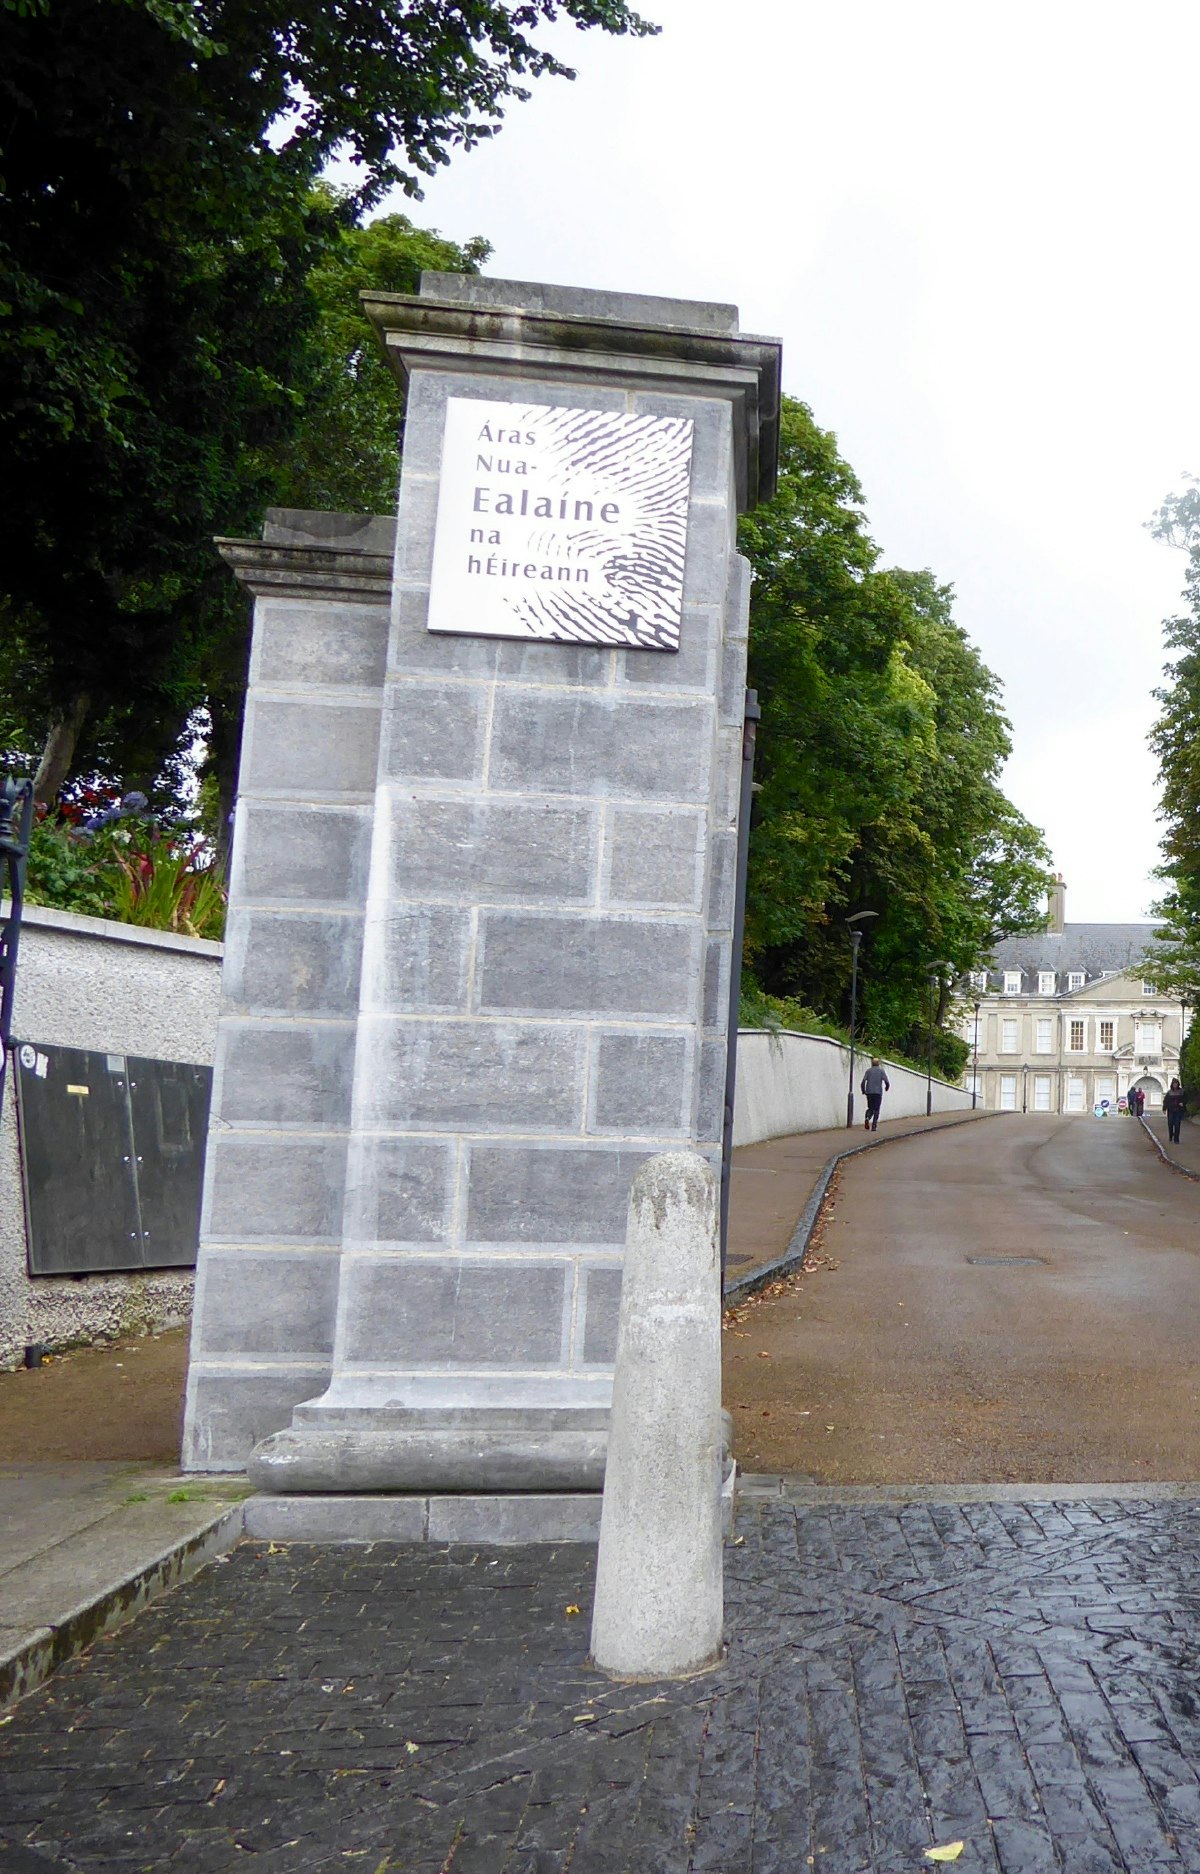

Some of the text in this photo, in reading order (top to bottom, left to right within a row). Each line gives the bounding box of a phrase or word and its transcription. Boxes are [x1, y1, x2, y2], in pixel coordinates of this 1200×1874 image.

[477, 419, 537, 446] Áras
[476, 454, 538, 476] Nua-
[472, 486, 621, 524] Ealaíne
[469, 527, 502, 546] na
[467, 552, 590, 583] hÉireann
